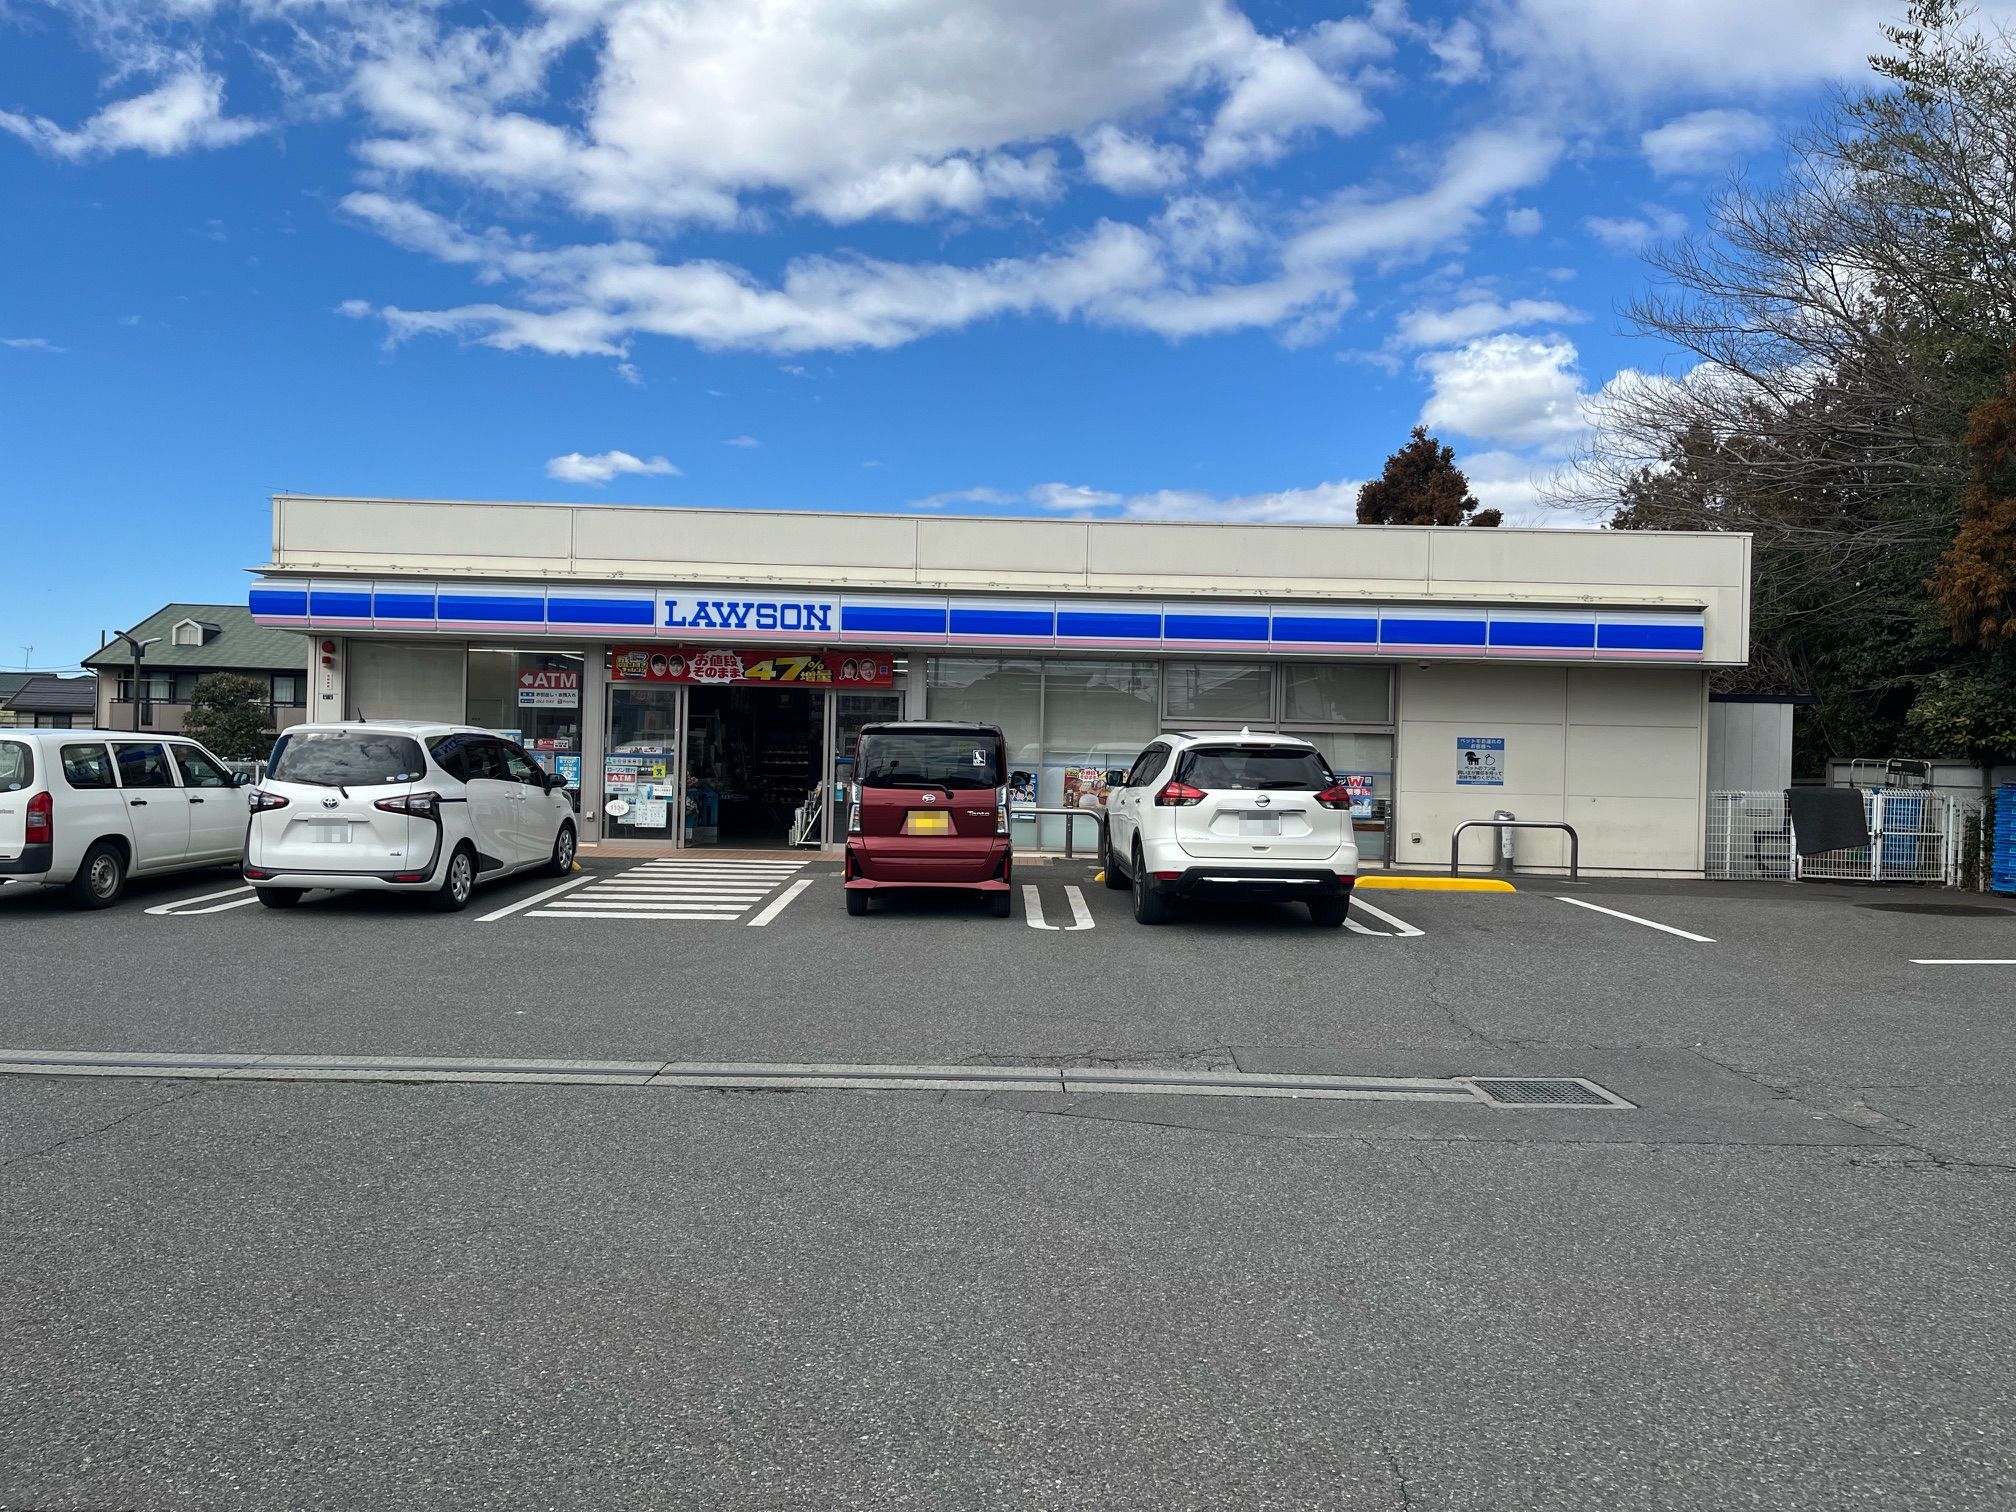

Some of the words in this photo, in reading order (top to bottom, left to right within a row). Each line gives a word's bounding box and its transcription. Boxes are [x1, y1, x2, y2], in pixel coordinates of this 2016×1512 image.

[664, 600, 832, 631] LAWSON
[694, 654, 738, 667] お値段
[693, 667, 741, 678] そのまま
[800, 669, 832, 683] 増量
[533, 672, 577, 688] ATM
[612, 774, 631, 782] ATM
